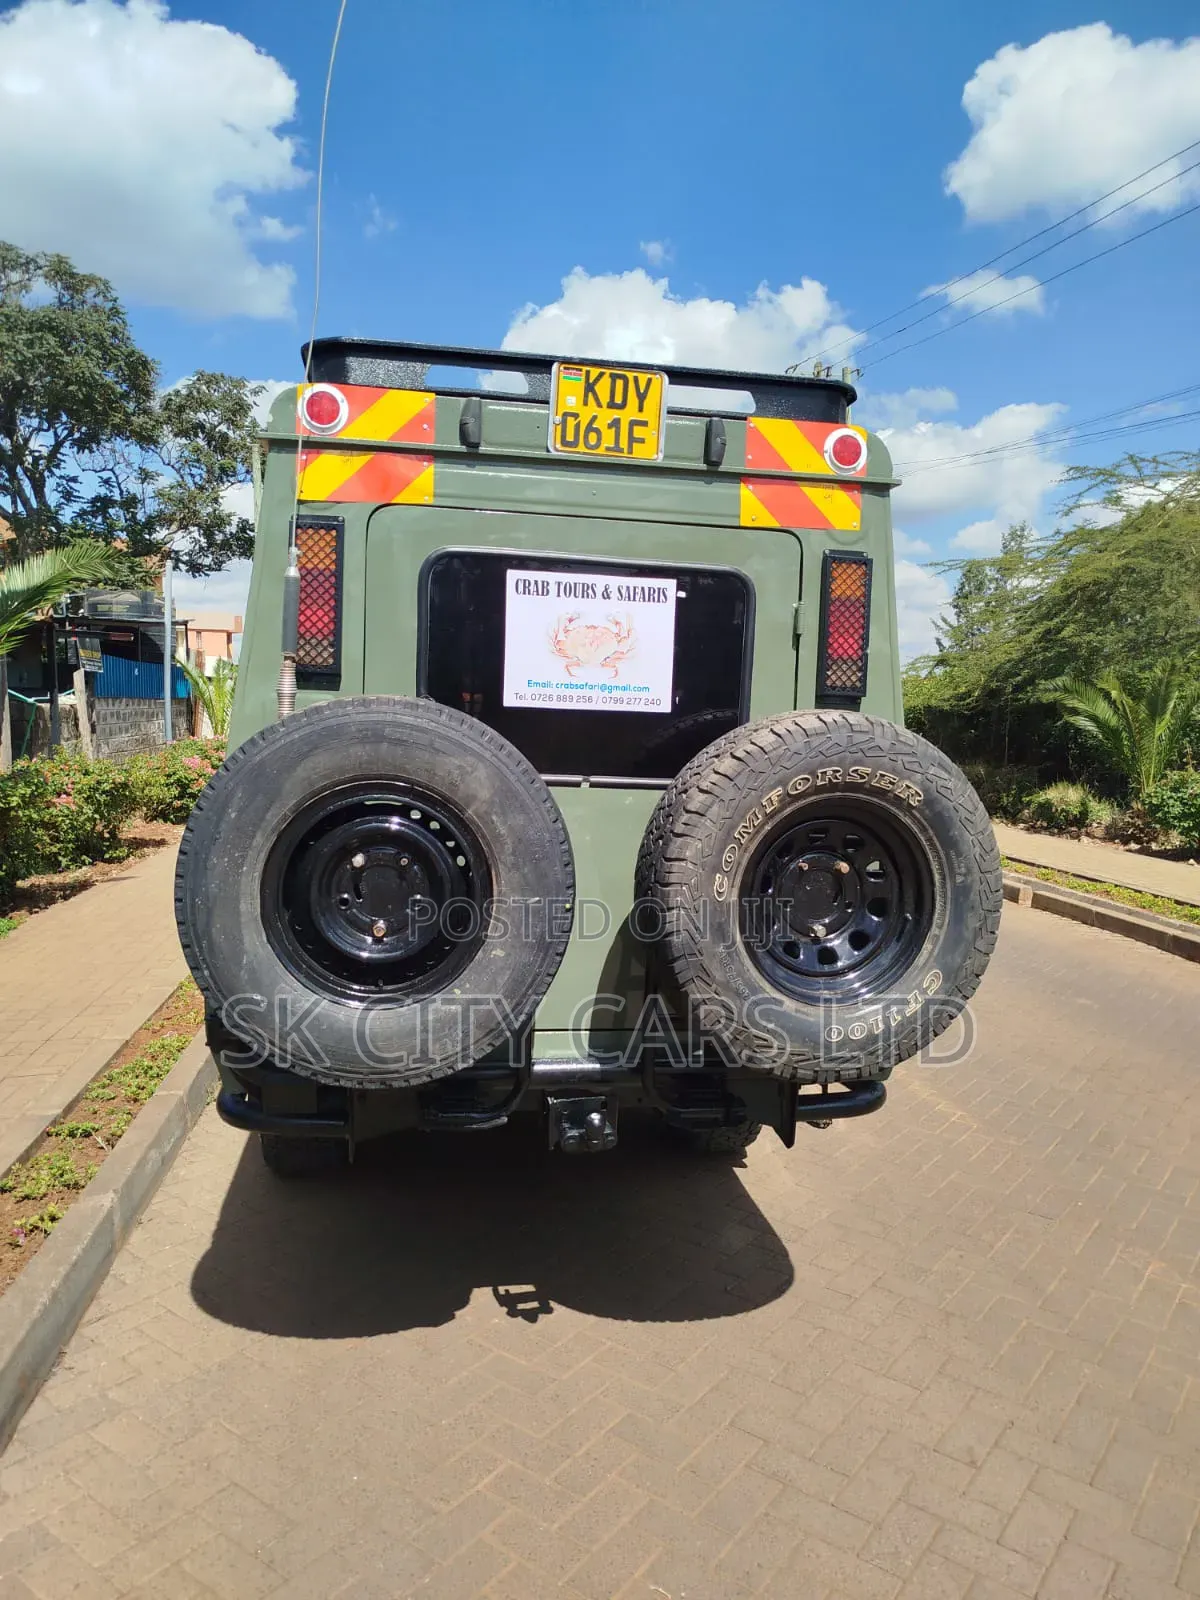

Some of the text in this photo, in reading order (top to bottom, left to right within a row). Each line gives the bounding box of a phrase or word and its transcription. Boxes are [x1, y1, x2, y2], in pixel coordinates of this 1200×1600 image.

[582, 369, 652, 412] KDY
[560, 411, 649, 454] 061F
[515, 578, 668, 603] CRAB TOURS & SAFARIS
[514, 692, 528, 702] Tel.
[530, 693, 554, 702] 0726
[556, 694, 574, 703] 889
[601, 696, 624, 705] 0799
[626, 697, 642, 705] 277
[644, 698, 662, 706] 240
[527, 680, 650, 694] Email: crabsafari@gmail.com
[713, 766, 925, 902] COMFORSER
[824, 969, 943, 1042] CF1100
